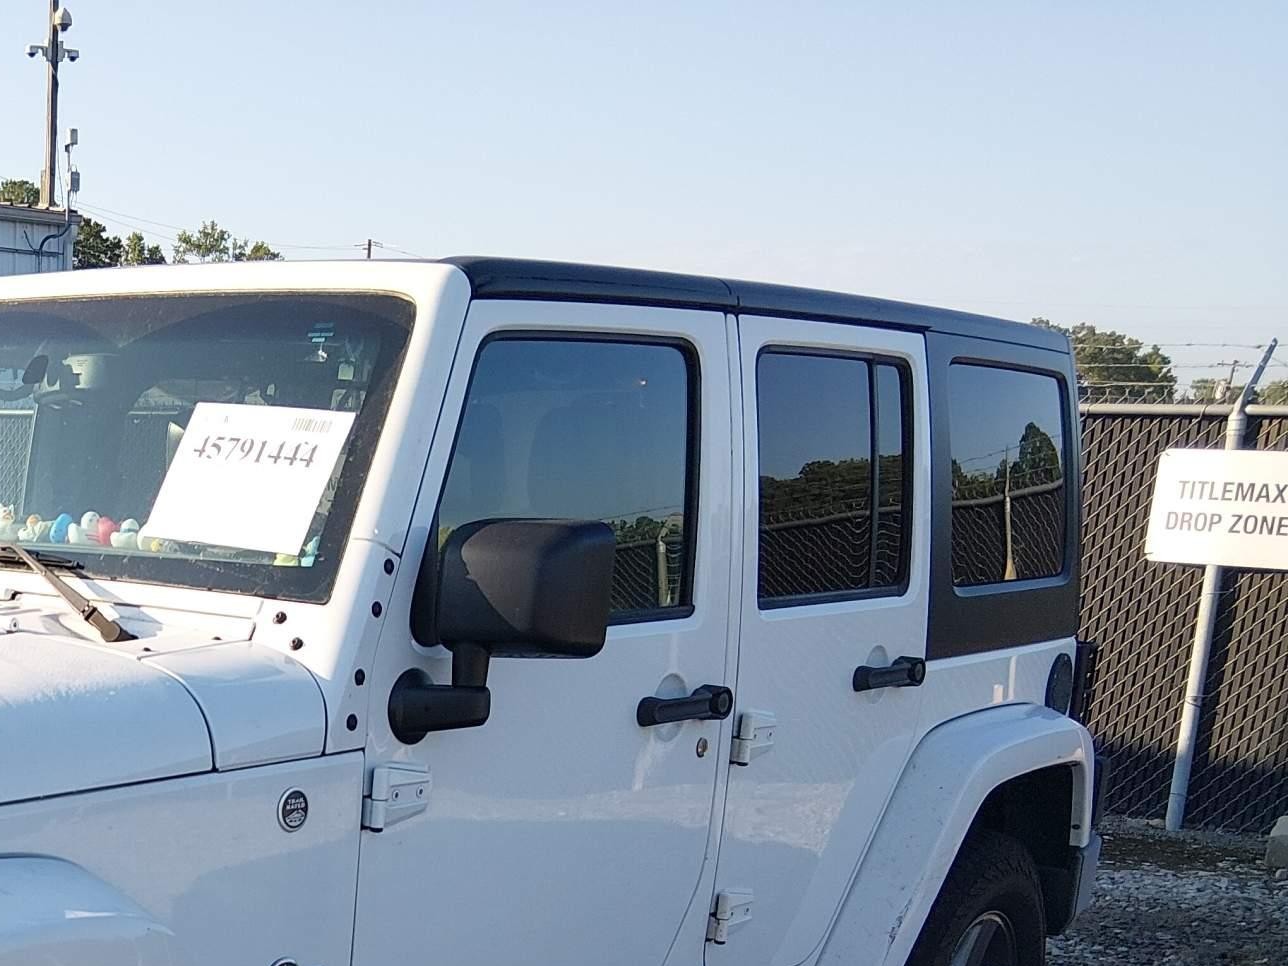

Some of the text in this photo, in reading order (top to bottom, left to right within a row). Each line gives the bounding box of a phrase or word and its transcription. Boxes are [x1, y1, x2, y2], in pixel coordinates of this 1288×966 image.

[193, 435, 318, 468] 45791444
[1178, 480, 1288, 503] TITLEMAX
[1165, 511, 1288, 536] DROP ZONE
